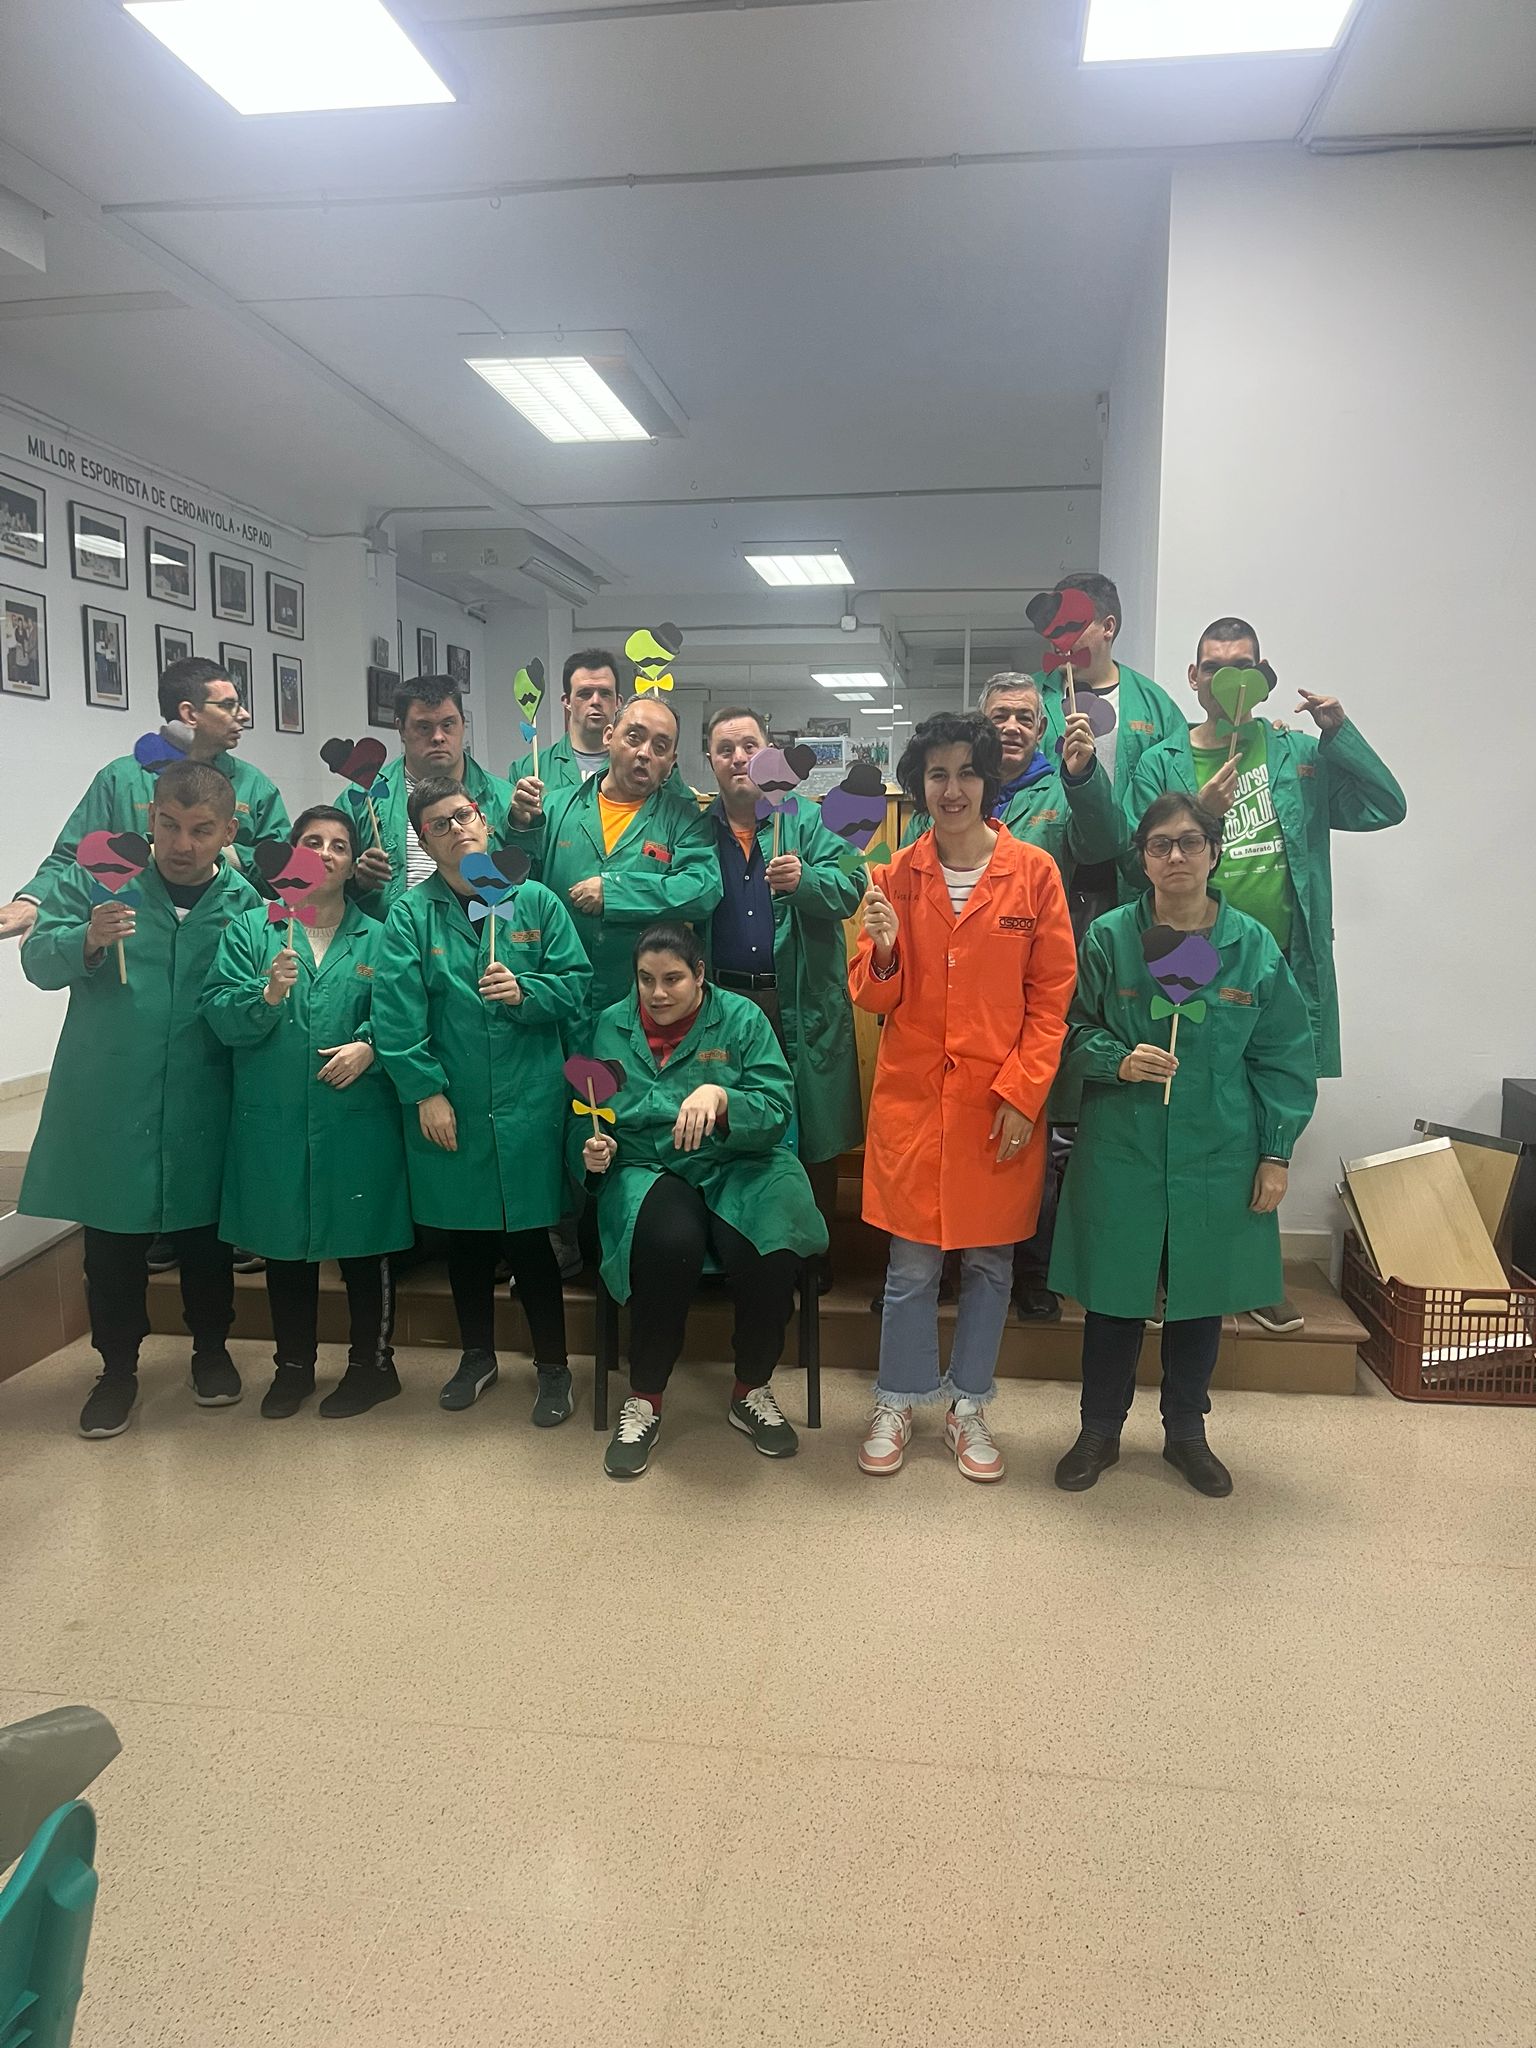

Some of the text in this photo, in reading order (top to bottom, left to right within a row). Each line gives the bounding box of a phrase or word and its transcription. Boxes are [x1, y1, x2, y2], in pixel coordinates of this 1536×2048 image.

[28, 434, 77, 473] MILLOR
[81, 456, 149, 502] ESPORTISTA
[151, 486, 166, 509] DE
[169, 495, 235, 534] CERDANYOLA
[241, 523, 272, 549] ASPADI
[1244, 845, 1272, 855] Marató
